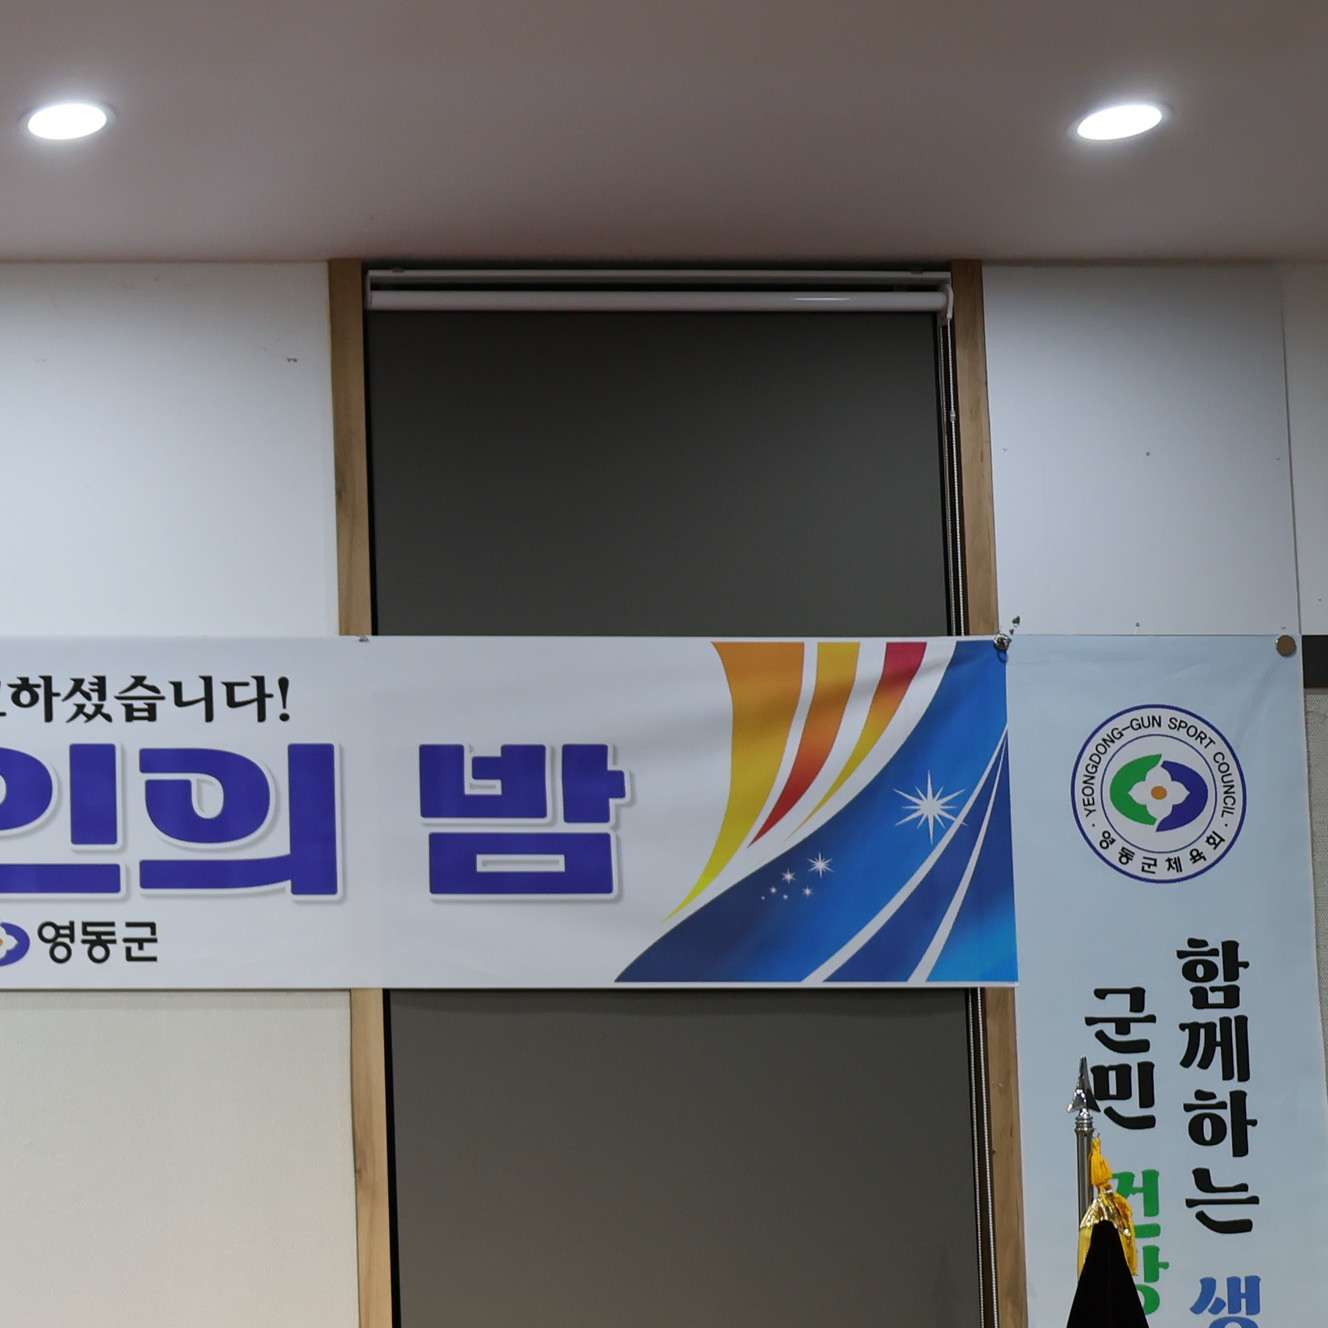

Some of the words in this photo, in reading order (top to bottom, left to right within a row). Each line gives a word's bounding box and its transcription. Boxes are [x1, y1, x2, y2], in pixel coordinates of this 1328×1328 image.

[419, 744, 626, 895] 밤
[1082, 715, 1162, 818] YEONGDONG-GUN
[1167, 716, 1216, 750] SPORT
[1213, 751, 1237, 819] COUNCIL
[1099, 830, 1226, 874] 영동군체육회
[36, 920, 158, 964] 영동군
[1085, 986, 1157, 1131] 군민
[1176, 937, 1260, 1235] 함께하는
